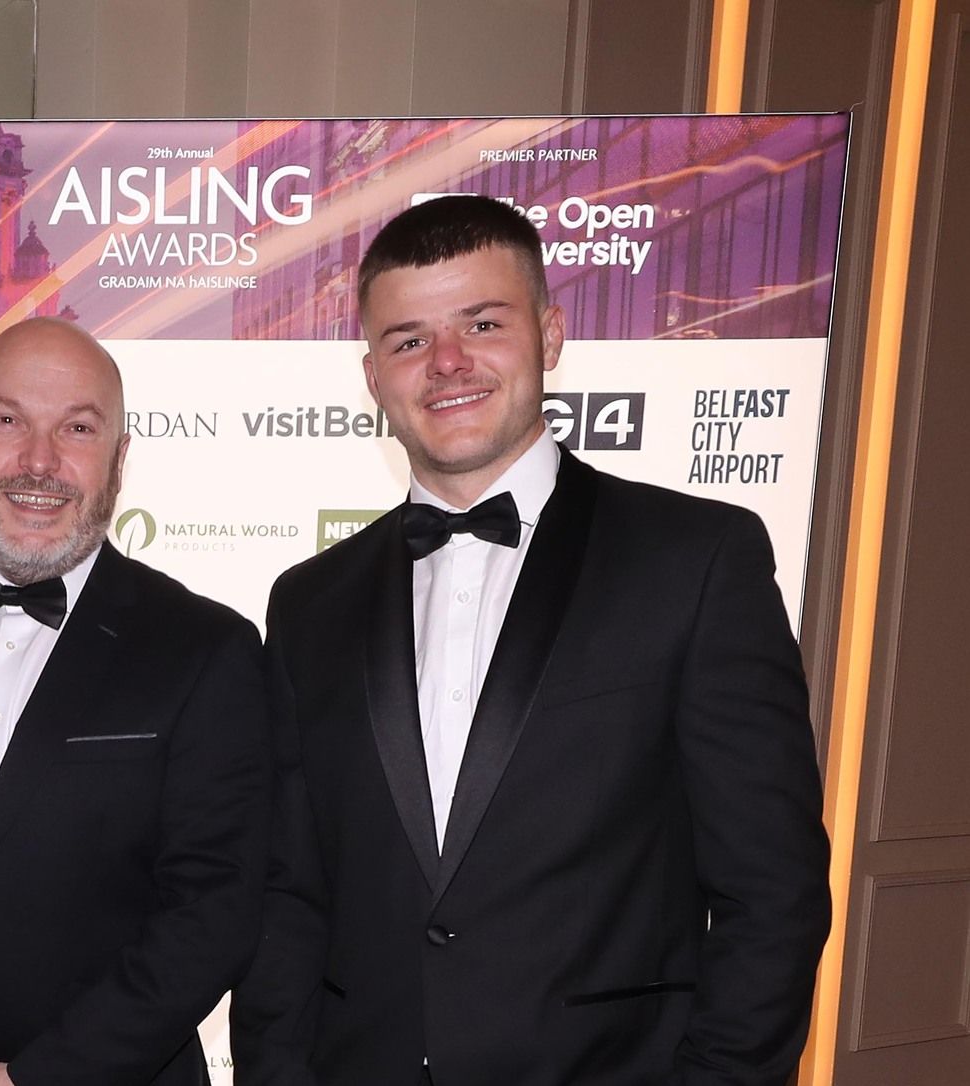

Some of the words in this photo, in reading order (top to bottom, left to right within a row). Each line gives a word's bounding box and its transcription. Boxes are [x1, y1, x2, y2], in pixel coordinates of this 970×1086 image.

[147, 147, 172, 159] 29th
[176, 147, 214, 159] Annual
[480, 150, 535, 162] PREMIER
[538, 149, 598, 161] PARTNER
[48, 165, 313, 226] AISLING
[558, 197, 655, 238] Open
[97, 232, 258, 266] AWARDS
[542, 233, 652, 274] versity
[99, 275, 163, 289] GRADAIM
[166, 275, 187, 289] NA
[694, 389, 791, 418] BELFAST
[126, 411, 218, 438] RDAN
[542, 398, 635, 446] G4
[691, 421, 743, 451] CITY
[688, 454, 784, 484] AIRPORT
[165, 524, 236, 537] NATURAL
[241, 524, 299, 537] WORLD
[165, 543, 236, 552] PRODUCTS
